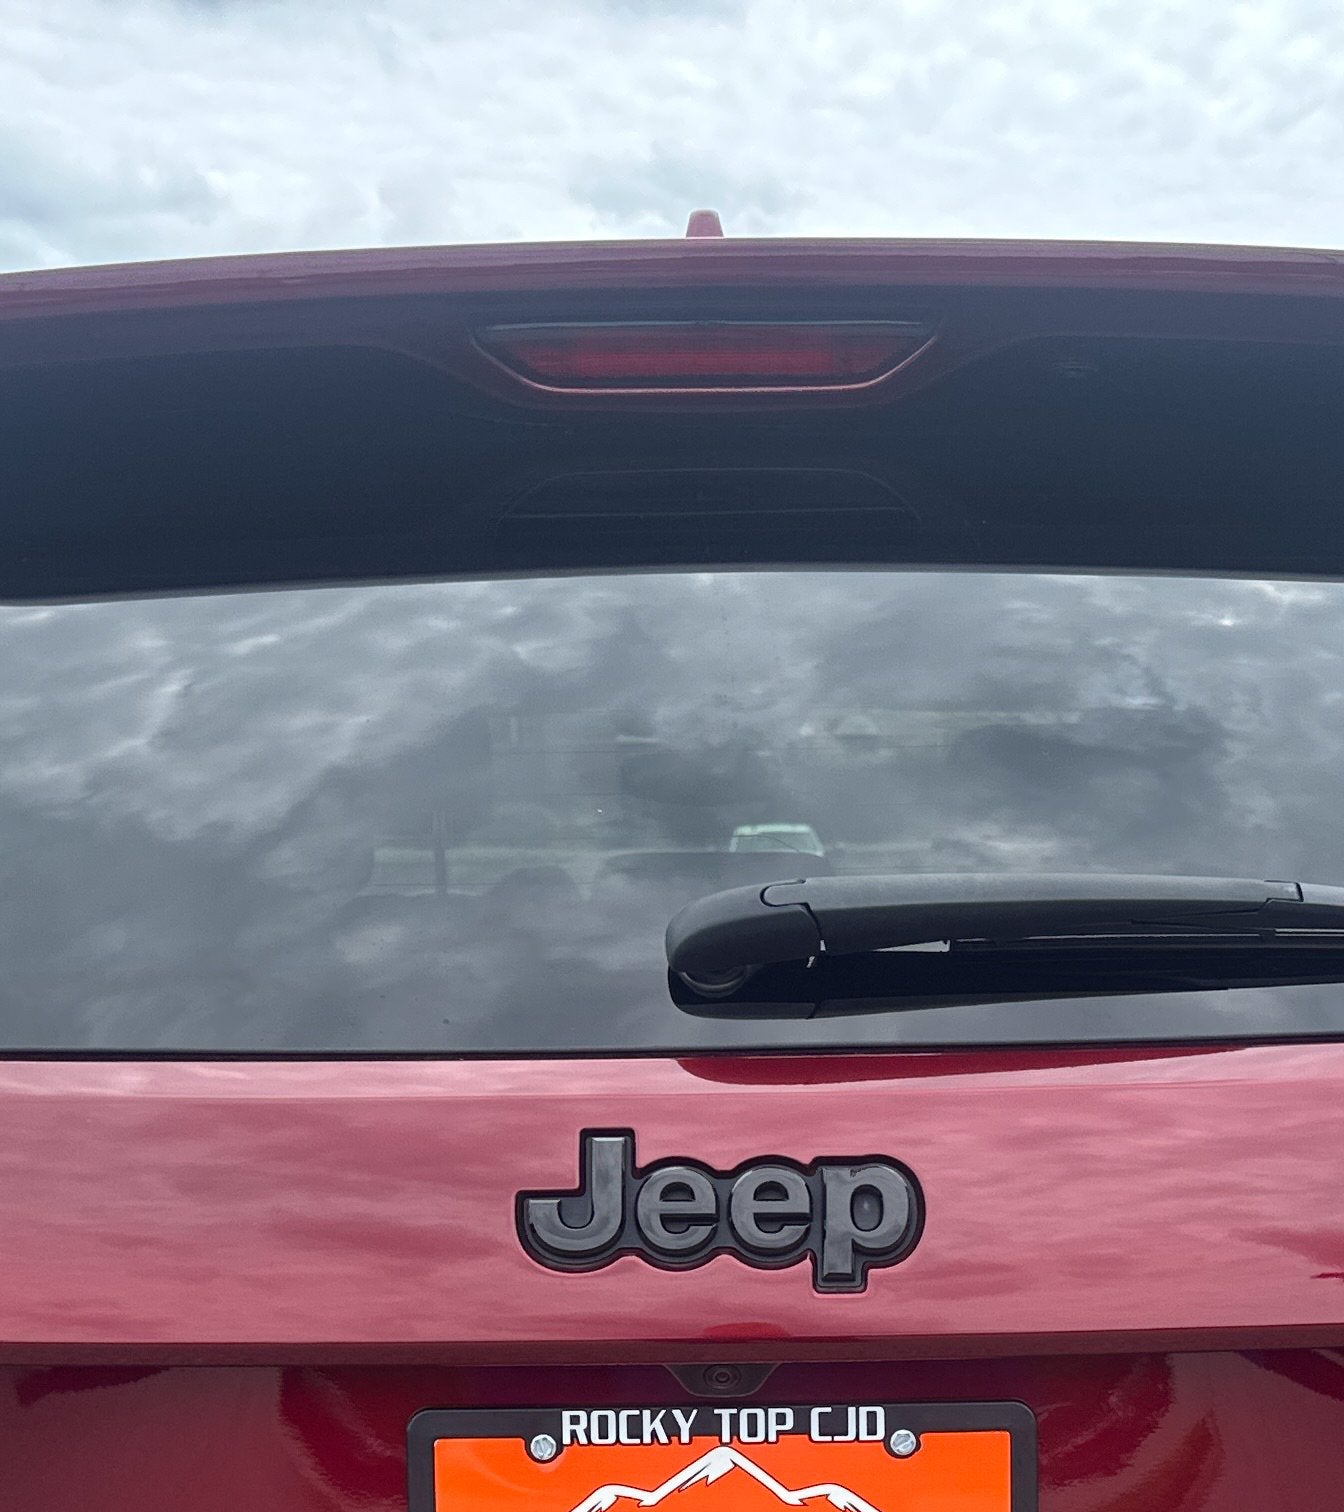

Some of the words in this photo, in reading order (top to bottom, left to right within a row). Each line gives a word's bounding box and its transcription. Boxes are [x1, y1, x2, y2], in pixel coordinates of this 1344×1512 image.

[522, 1134, 914, 1286] Jeep
[561, 1410, 698, 1445] ROCKY
[713, 1408, 795, 1443] TOP
[809, 1406, 887, 1442] CJD
